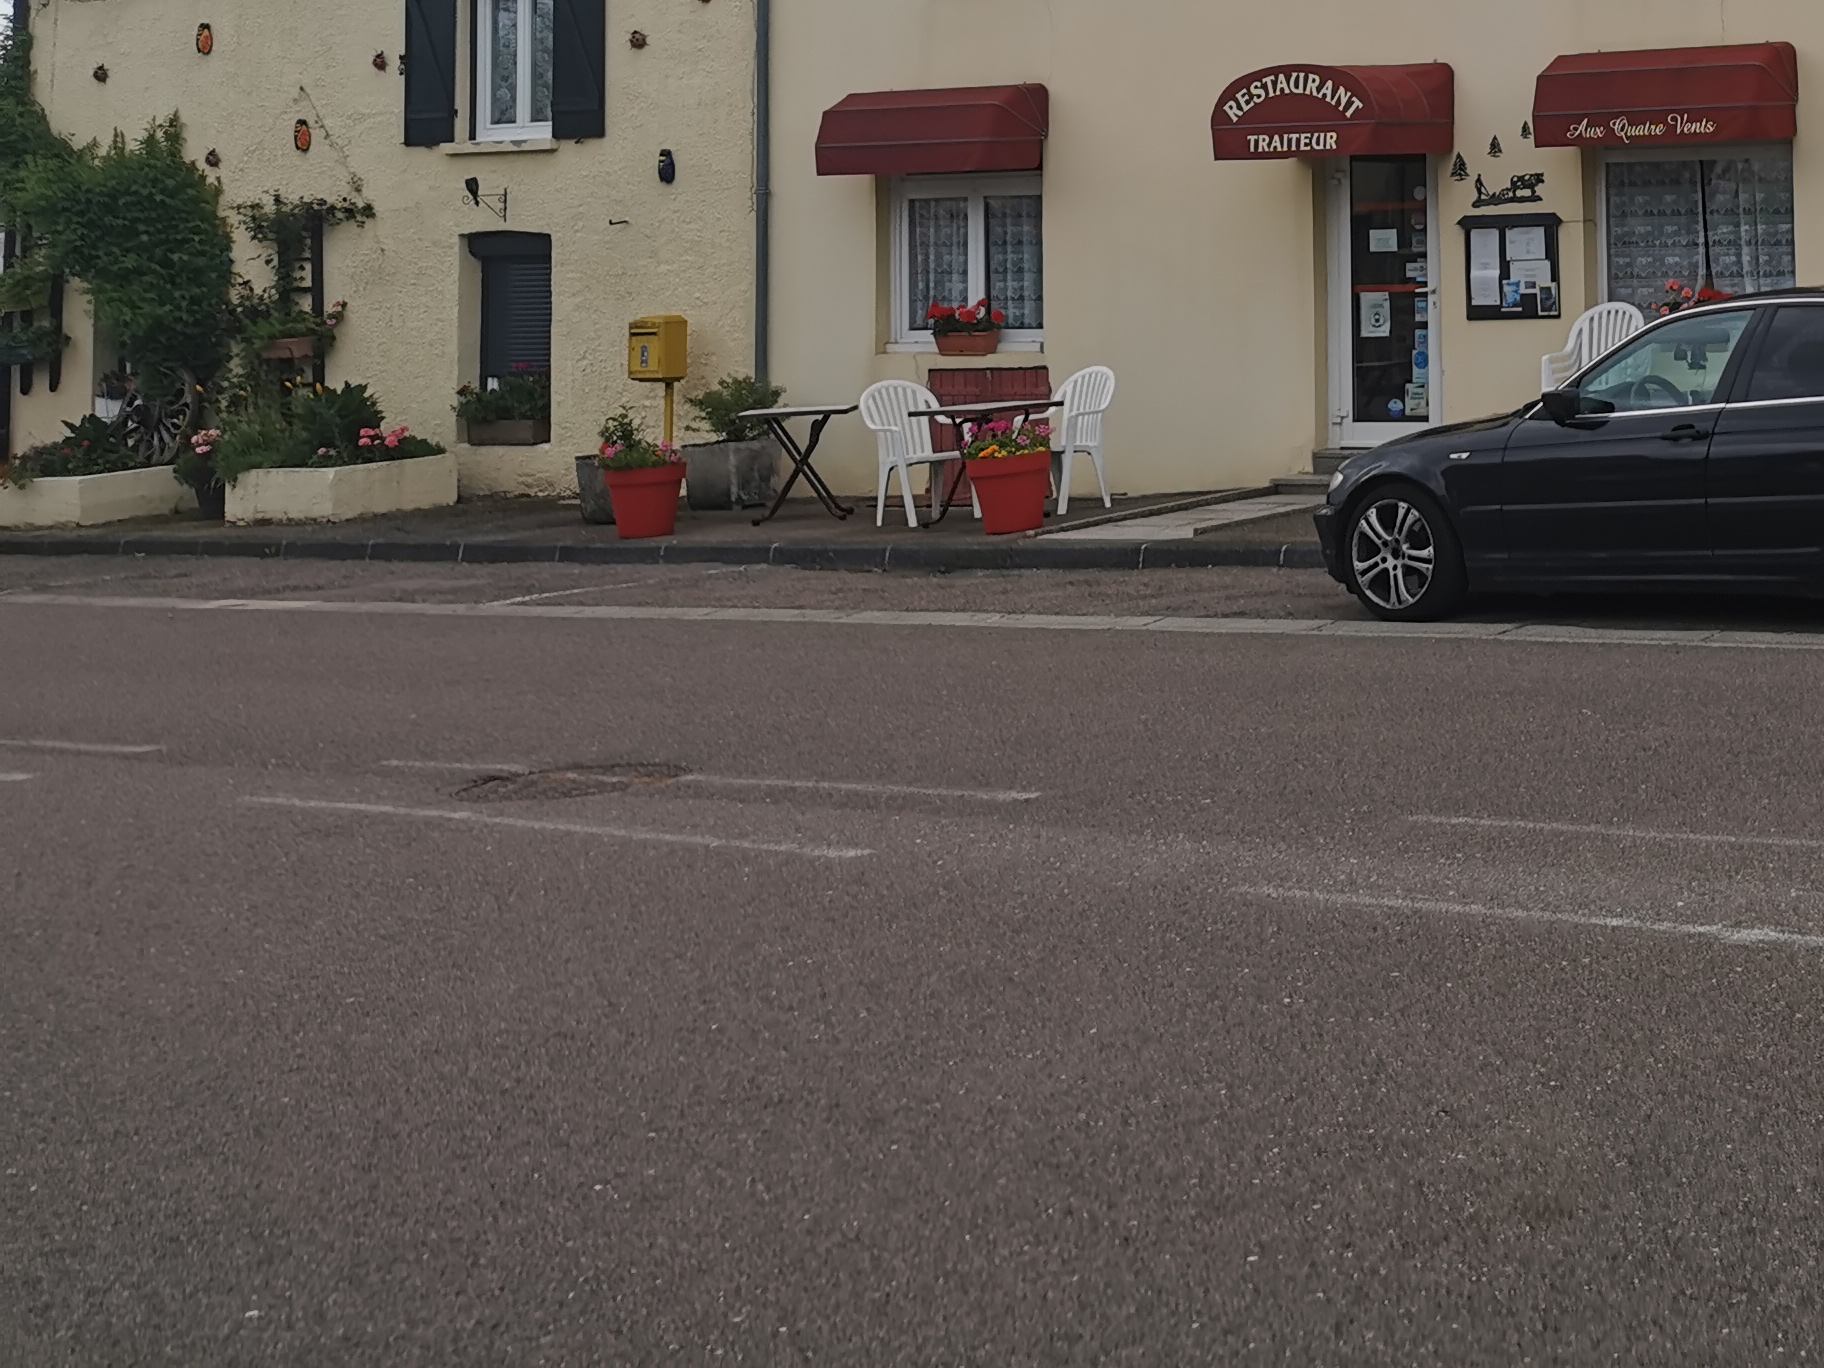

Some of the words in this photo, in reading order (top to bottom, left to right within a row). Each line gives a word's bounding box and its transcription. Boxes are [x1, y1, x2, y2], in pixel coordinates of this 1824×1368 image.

[1222, 71, 1365, 124] RESTAURANT
[1247, 131, 1338, 154] TRAITEUR
[1566, 117, 1606, 140] Aux
[1610, 114, 1667, 143] Quatre
[1668, 112, 1717, 135] Vents
